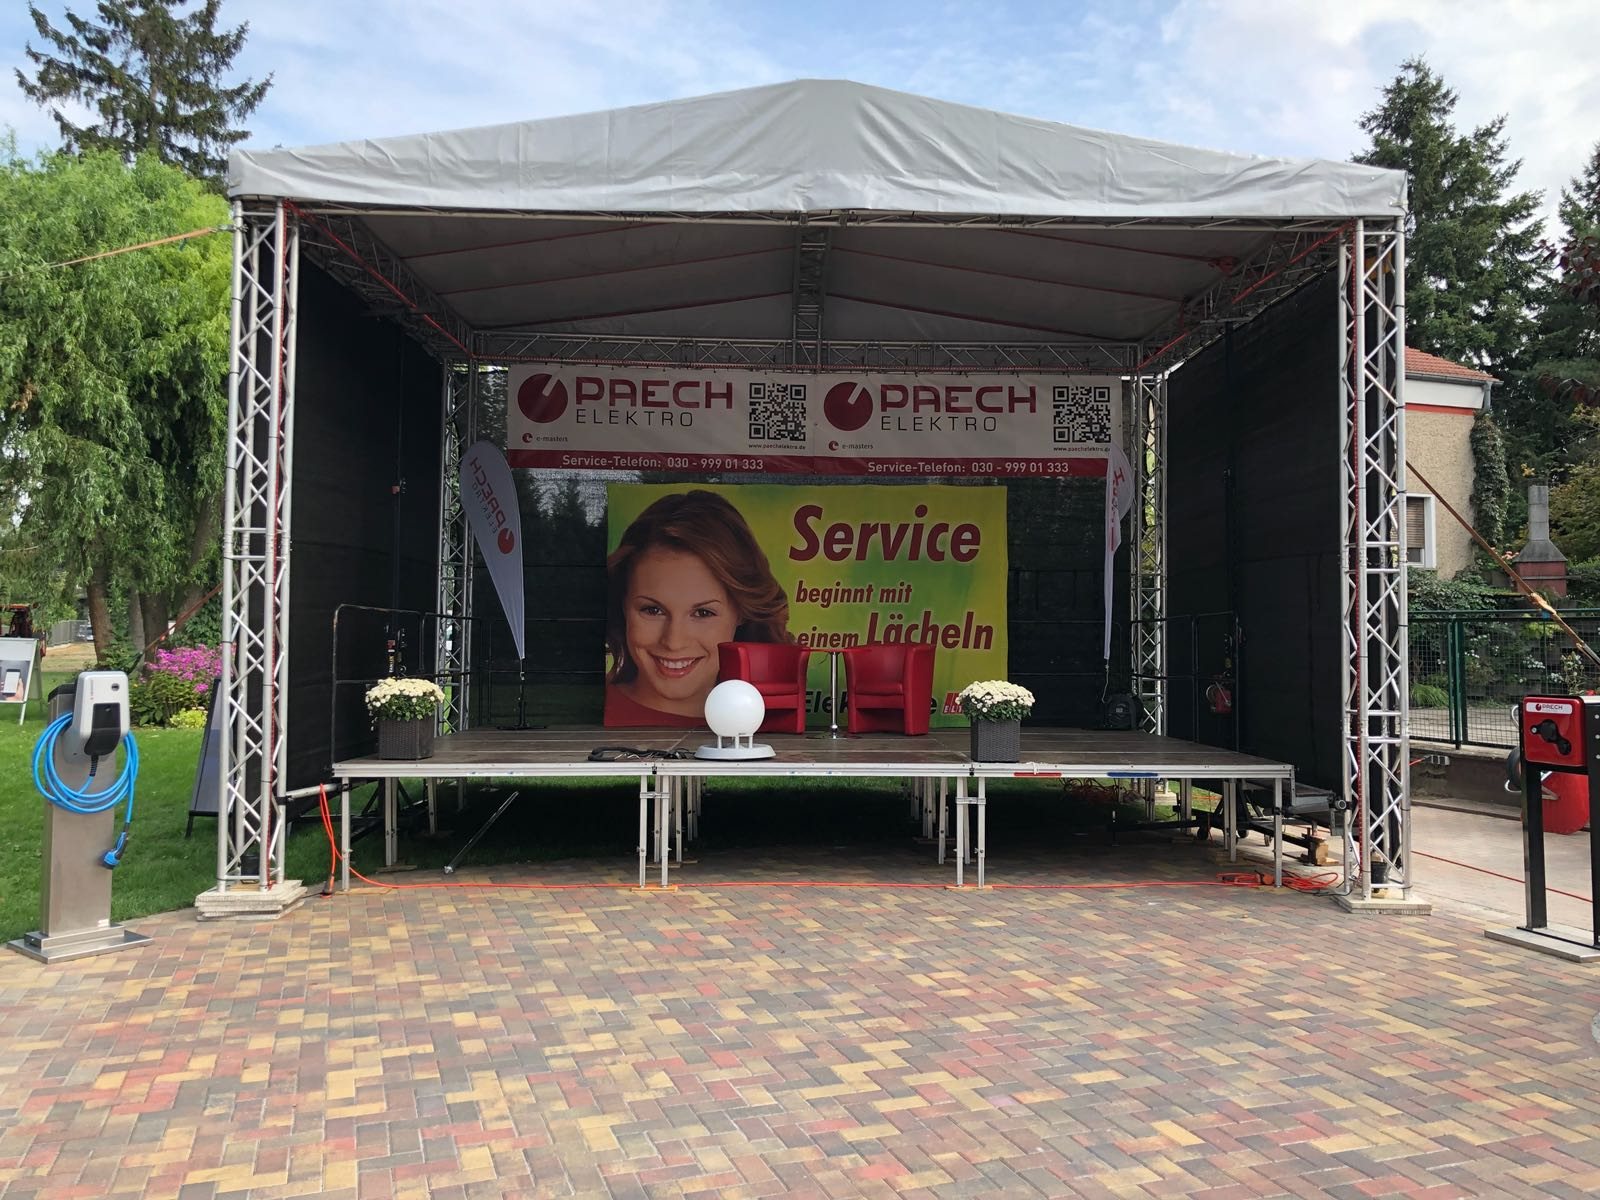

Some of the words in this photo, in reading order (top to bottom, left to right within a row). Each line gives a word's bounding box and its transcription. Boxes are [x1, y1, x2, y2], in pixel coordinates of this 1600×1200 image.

[575, 376, 733, 409] PAECH
[880, 384, 1037, 413] PAECH
[576, 408, 693, 427] ELEKTRO
[881, 415, 998, 432] ELEKTRO
[841, 442, 874, 450] e-masters
[562, 454, 661, 468] Service-Telefon:
[667, 457, 689, 468] 030
[701, 458, 721, 469] 999
[725, 458, 738, 469] 01
[742, 459, 764, 470] 333
[868, 461, 966, 473] Service-Telefon:
[971, 462, 993, 473] 030
[1005, 462, 1026, 473] 999
[1030, 462, 1043, 473] 01
[1047, 462, 1069, 473] 333
[789, 504, 981, 562] Service
[795, 580, 874, 608] beginnt
[879, 581, 913, 603] mit
[797, 626, 859, 648] einem
[866, 610, 994, 650] Lächeln
